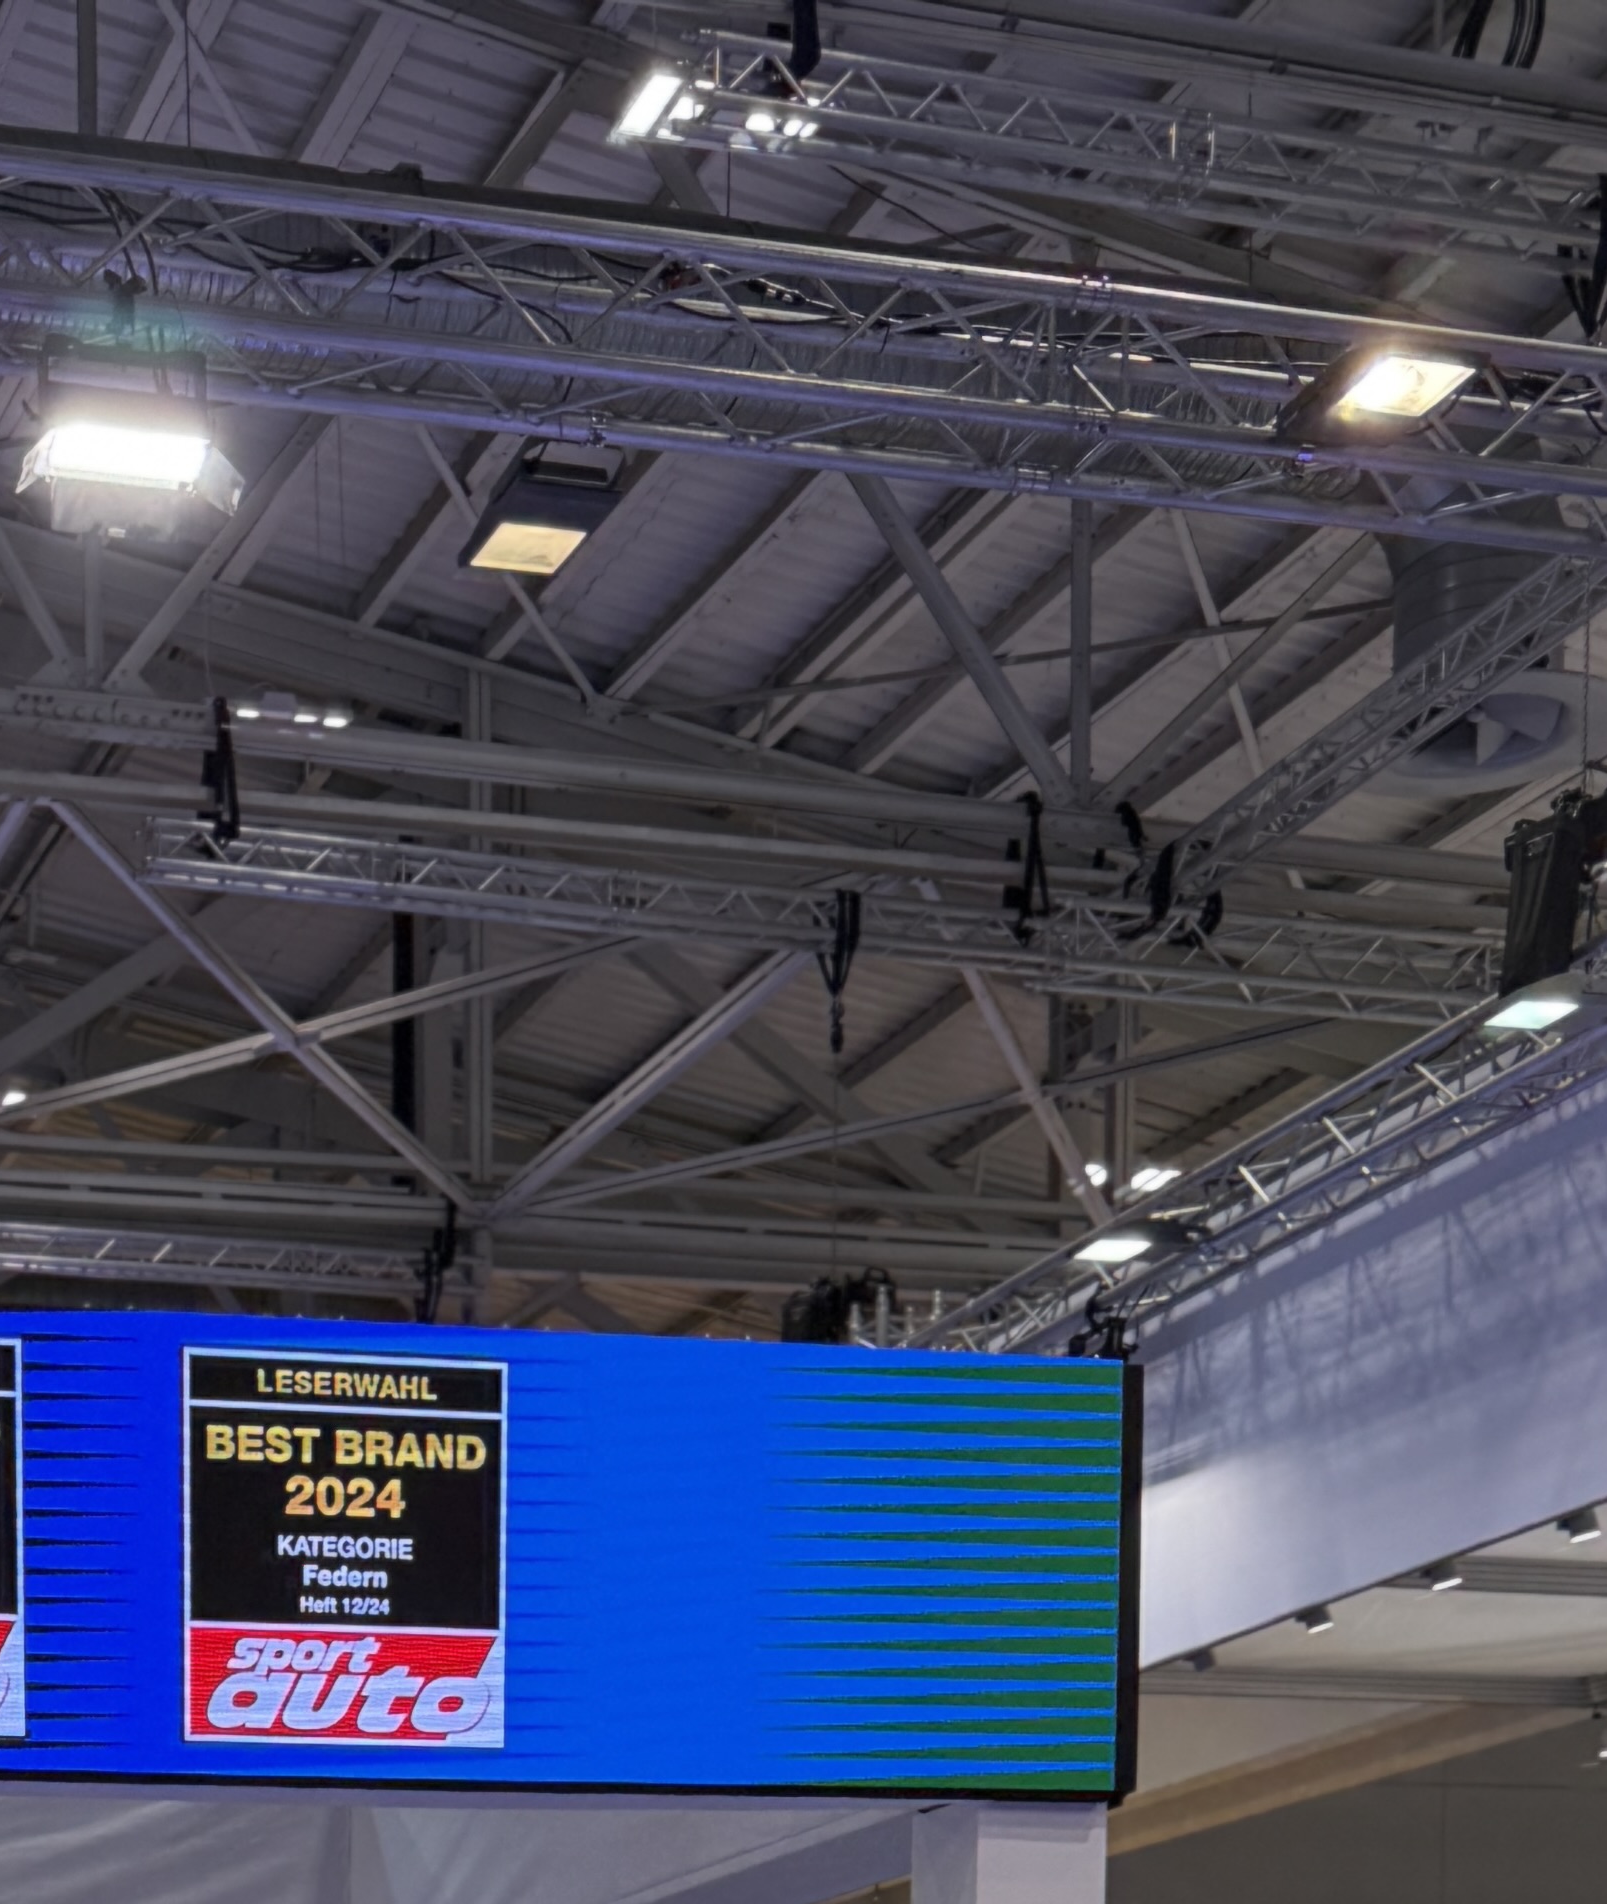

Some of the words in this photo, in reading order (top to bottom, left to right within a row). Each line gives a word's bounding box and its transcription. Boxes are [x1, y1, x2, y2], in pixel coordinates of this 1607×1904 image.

[257, 1369, 437, 1401] LESERWAHL
[206, 1424, 321, 1463] BEST
[335, 1430, 486, 1470] BRAND
[285, 1475, 406, 1518] 2024
[277, 1535, 414, 1560] KATEGORIE
[303, 1565, 388, 1588] Federn
[300, 1596, 337, 1613] Heft
[342, 1598, 390, 1615] 12/24
[227, 1637, 382, 1676] sport
[207, 1666, 491, 1732] auto
